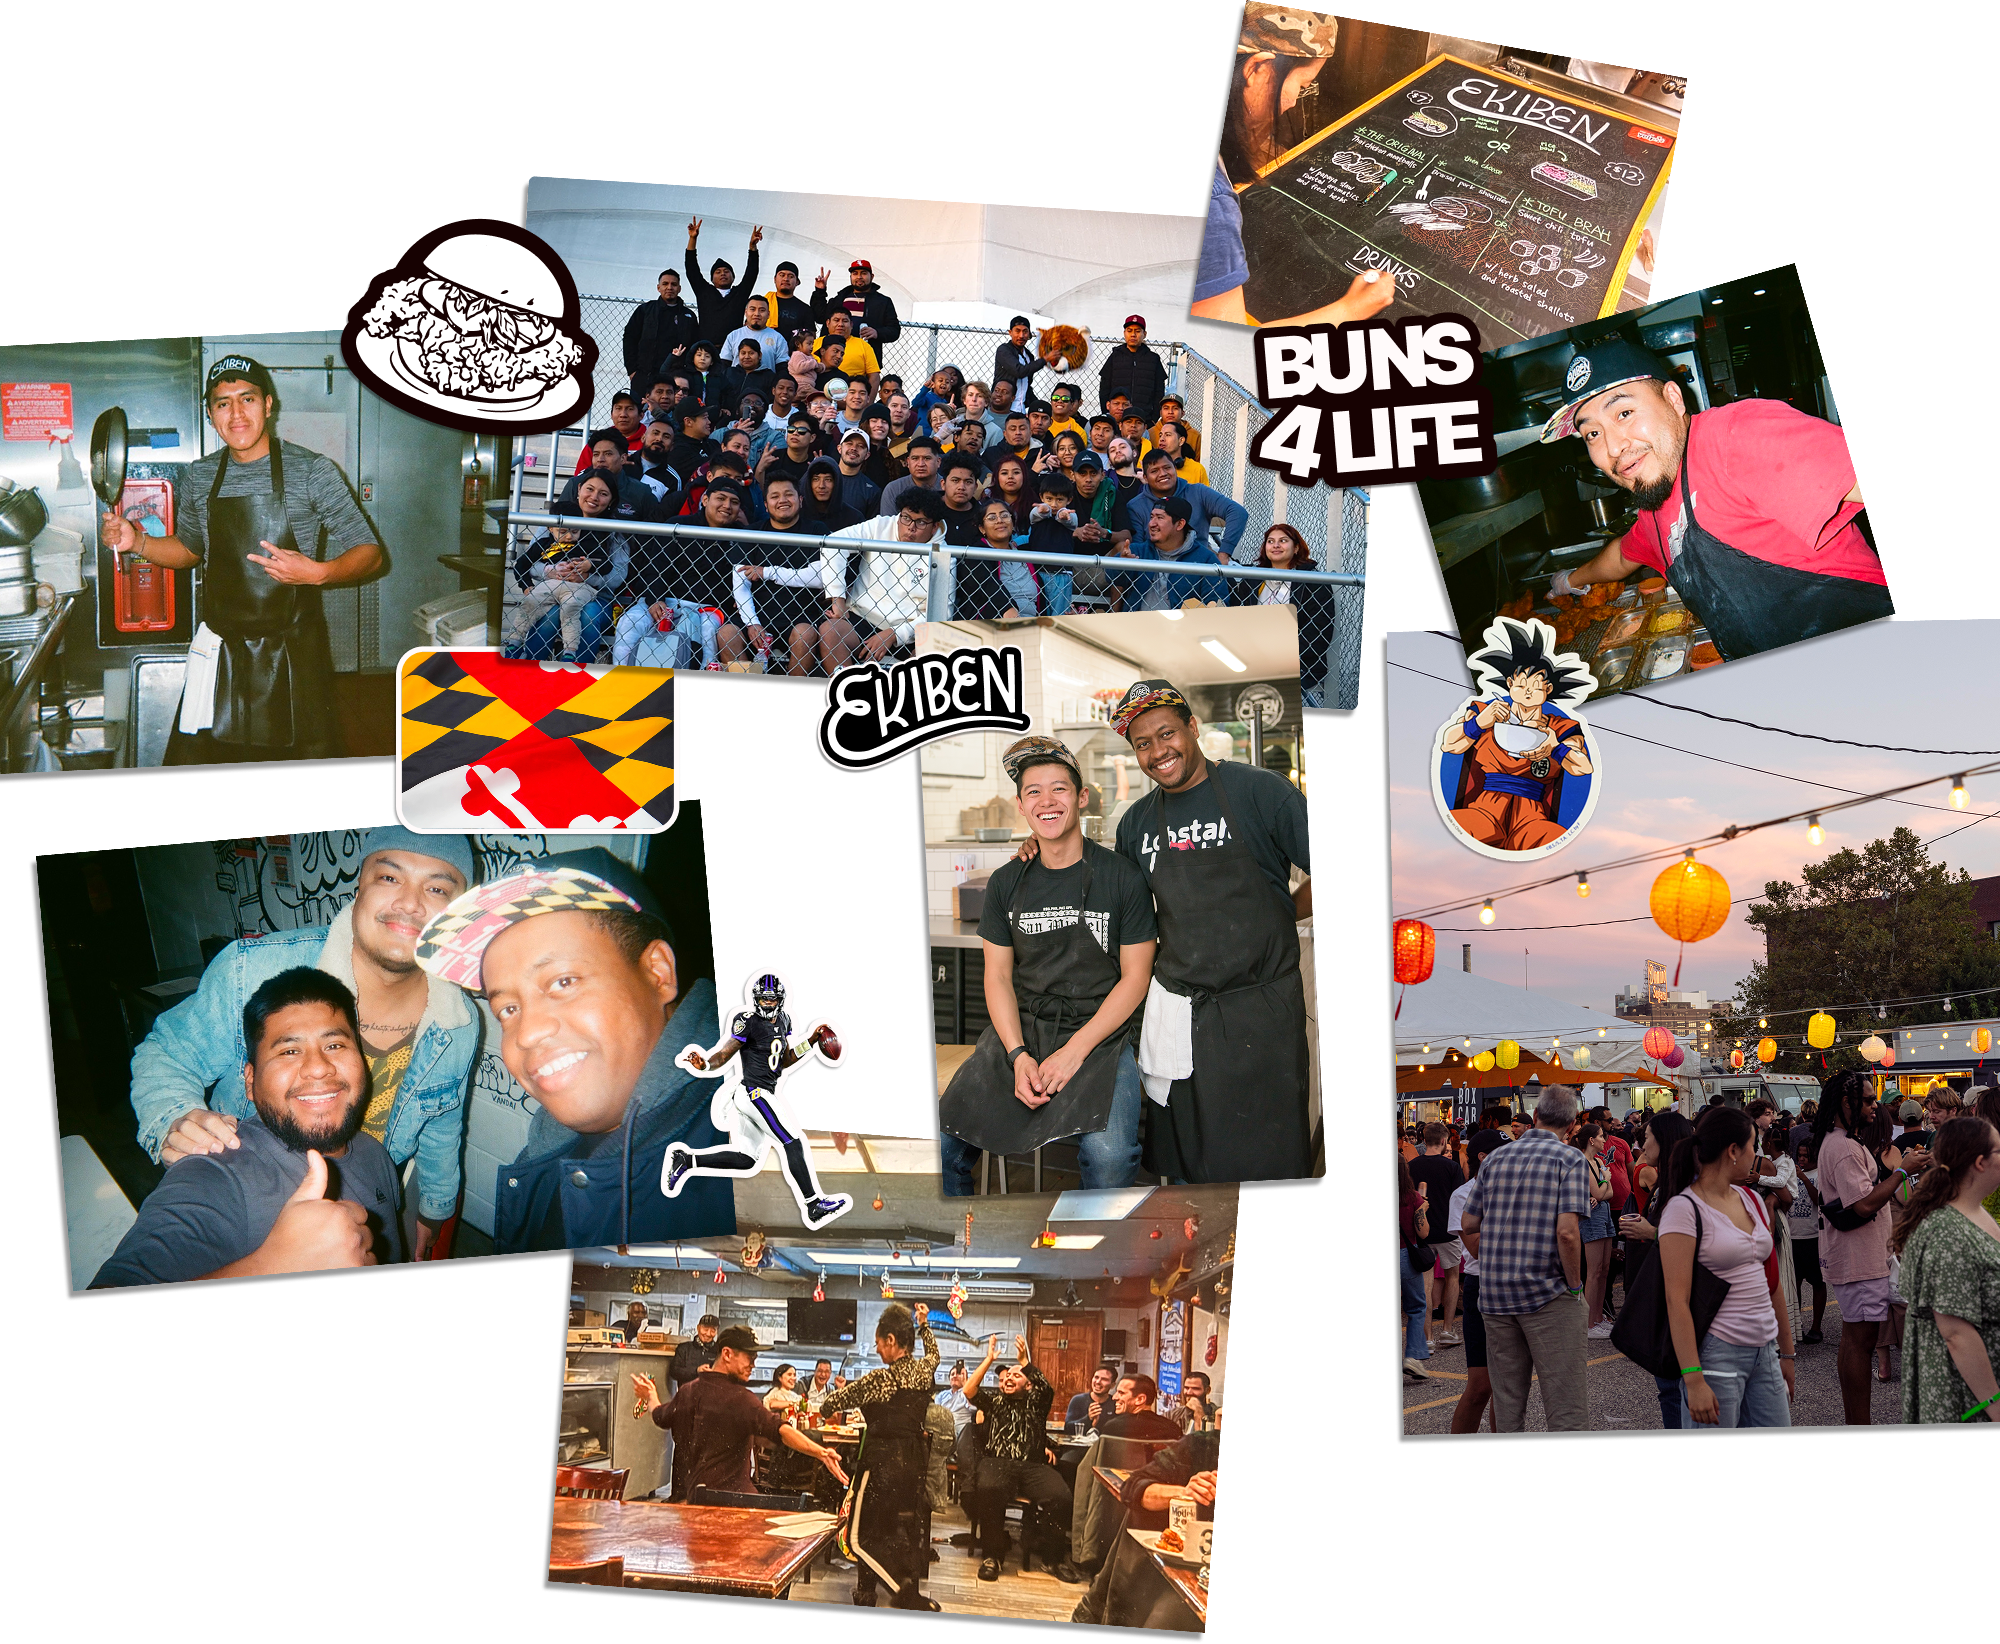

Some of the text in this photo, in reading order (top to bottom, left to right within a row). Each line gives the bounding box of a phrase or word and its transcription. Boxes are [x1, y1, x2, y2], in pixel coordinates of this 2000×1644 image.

[1447, 78, 1610, 155] EKIBEN
[1364, 141, 1387, 155] chicken
[1386, 151, 1418, 169] meatballs
[1366, 129, 1427, 161] THE ORIGINAL
[1486, 140, 1511, 154] OR
[1463, 155, 1503, 175] then choose
[1613, 166, 1638, 180] $12
[1296, 178, 1348, 204] and fresh herbs
[1302, 172, 1360, 201] roasted aromatics
[1316, 170, 1338, 184] papaya
[1339, 181, 1356, 191] slaw
[1402, 177, 1415, 185] OR
[1457, 181, 1476, 191] pork
[1478, 189, 1512, 206] shoulder
[1537, 201, 1569, 221] TOFU
[1494, 220, 1508, 229] OR
[1545, 222, 1564, 234] chili
[1570, 232, 1594, 247] tofu
[1352, 245, 1421, 289] DRINKS
[1485, 262, 1549, 298] w/ herb salad
[1481, 274, 1575, 323] and roasted shallots
[768, 1039, 783, 1072] 8
[1458, 1087, 1477, 1105] BOX
